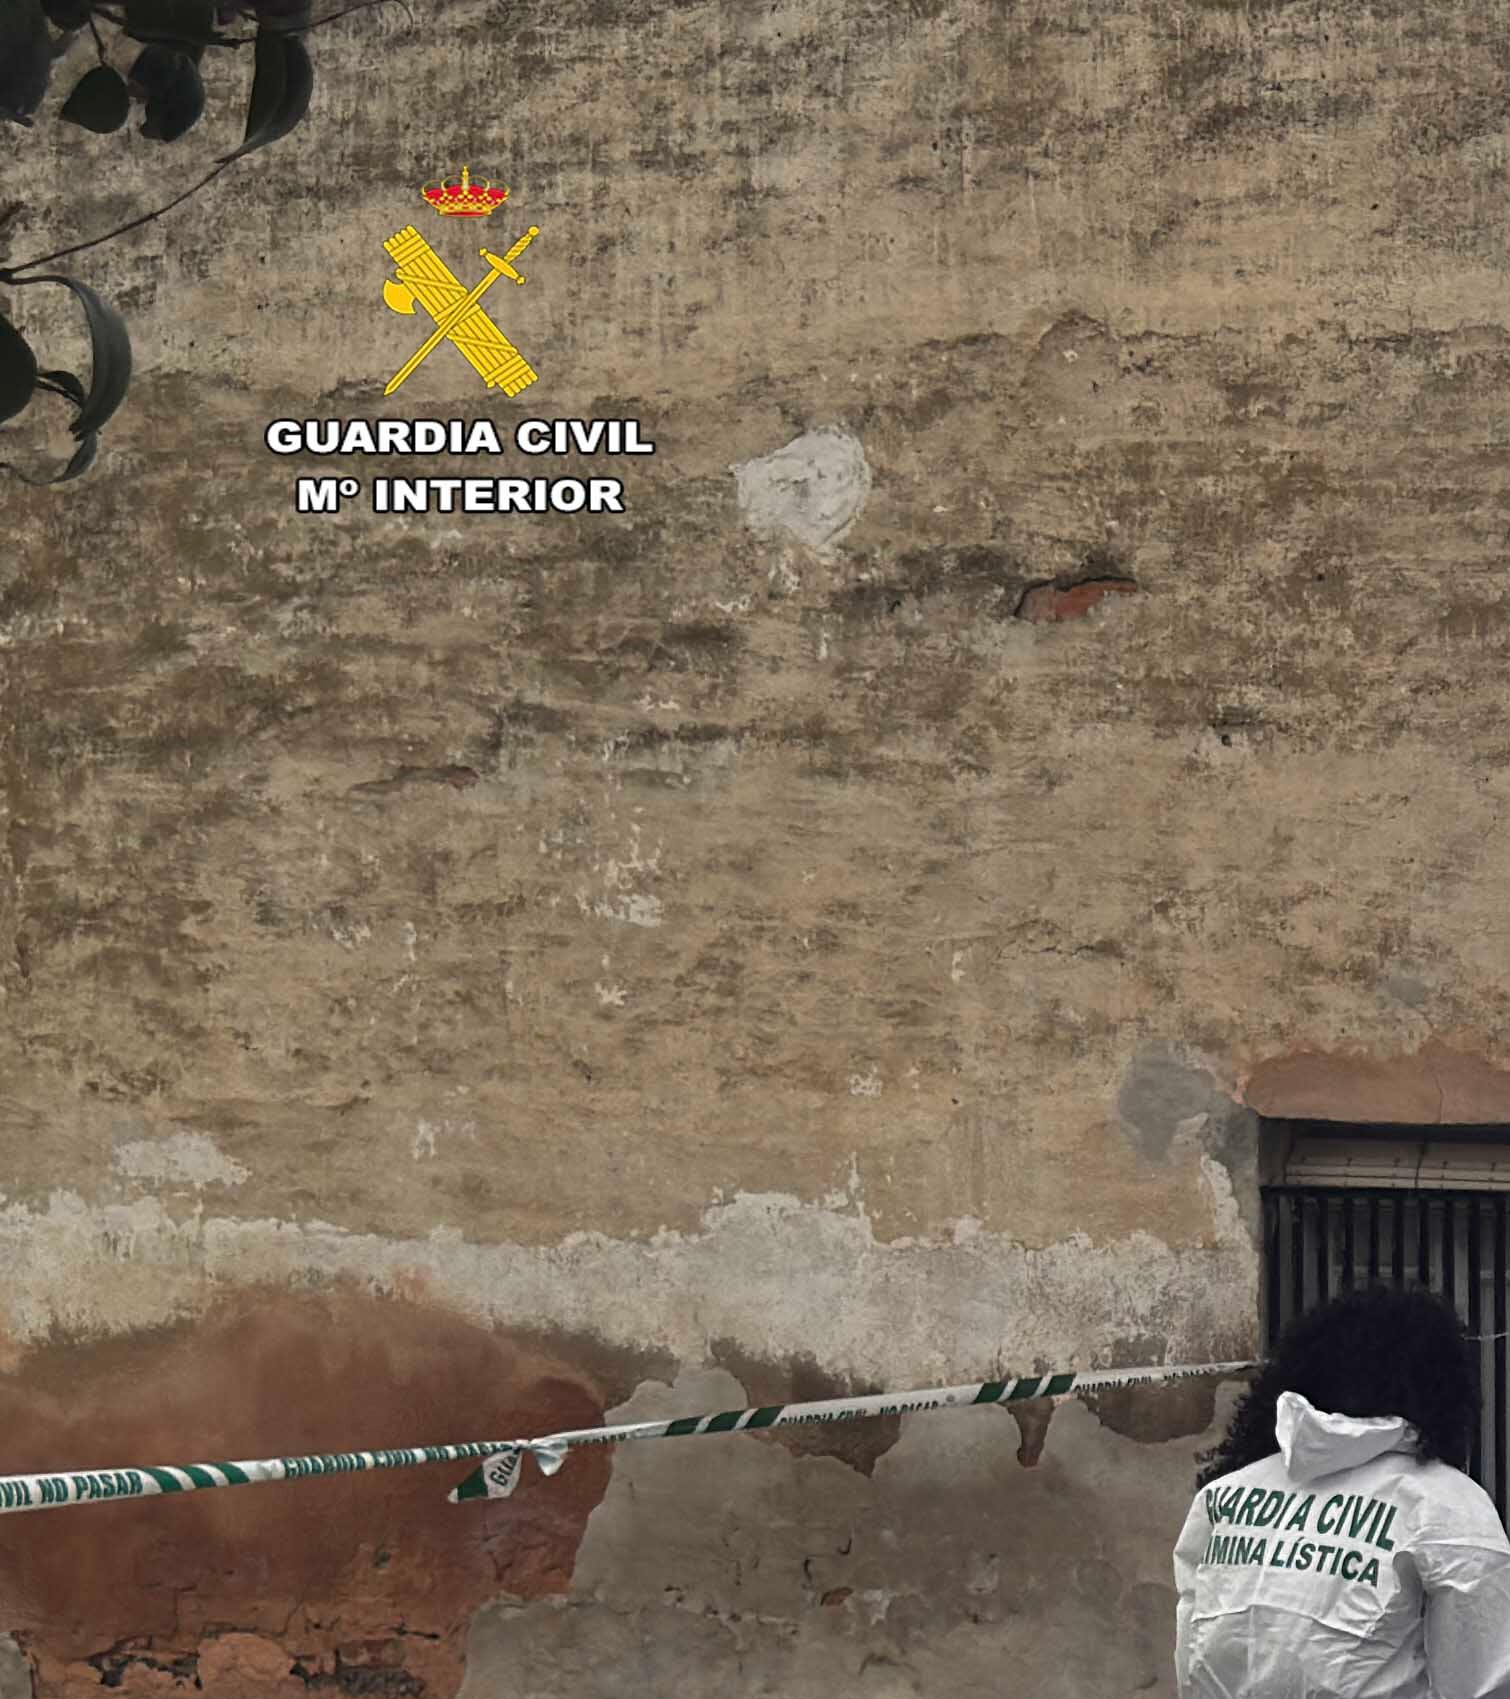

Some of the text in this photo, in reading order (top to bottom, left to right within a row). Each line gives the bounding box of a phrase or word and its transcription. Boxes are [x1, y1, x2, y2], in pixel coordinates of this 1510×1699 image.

[36, 1477, 69, 1504] NO
[71, 1470, 144, 1500] PASAR
[1316, 1494, 1398, 1551] CIVIL
